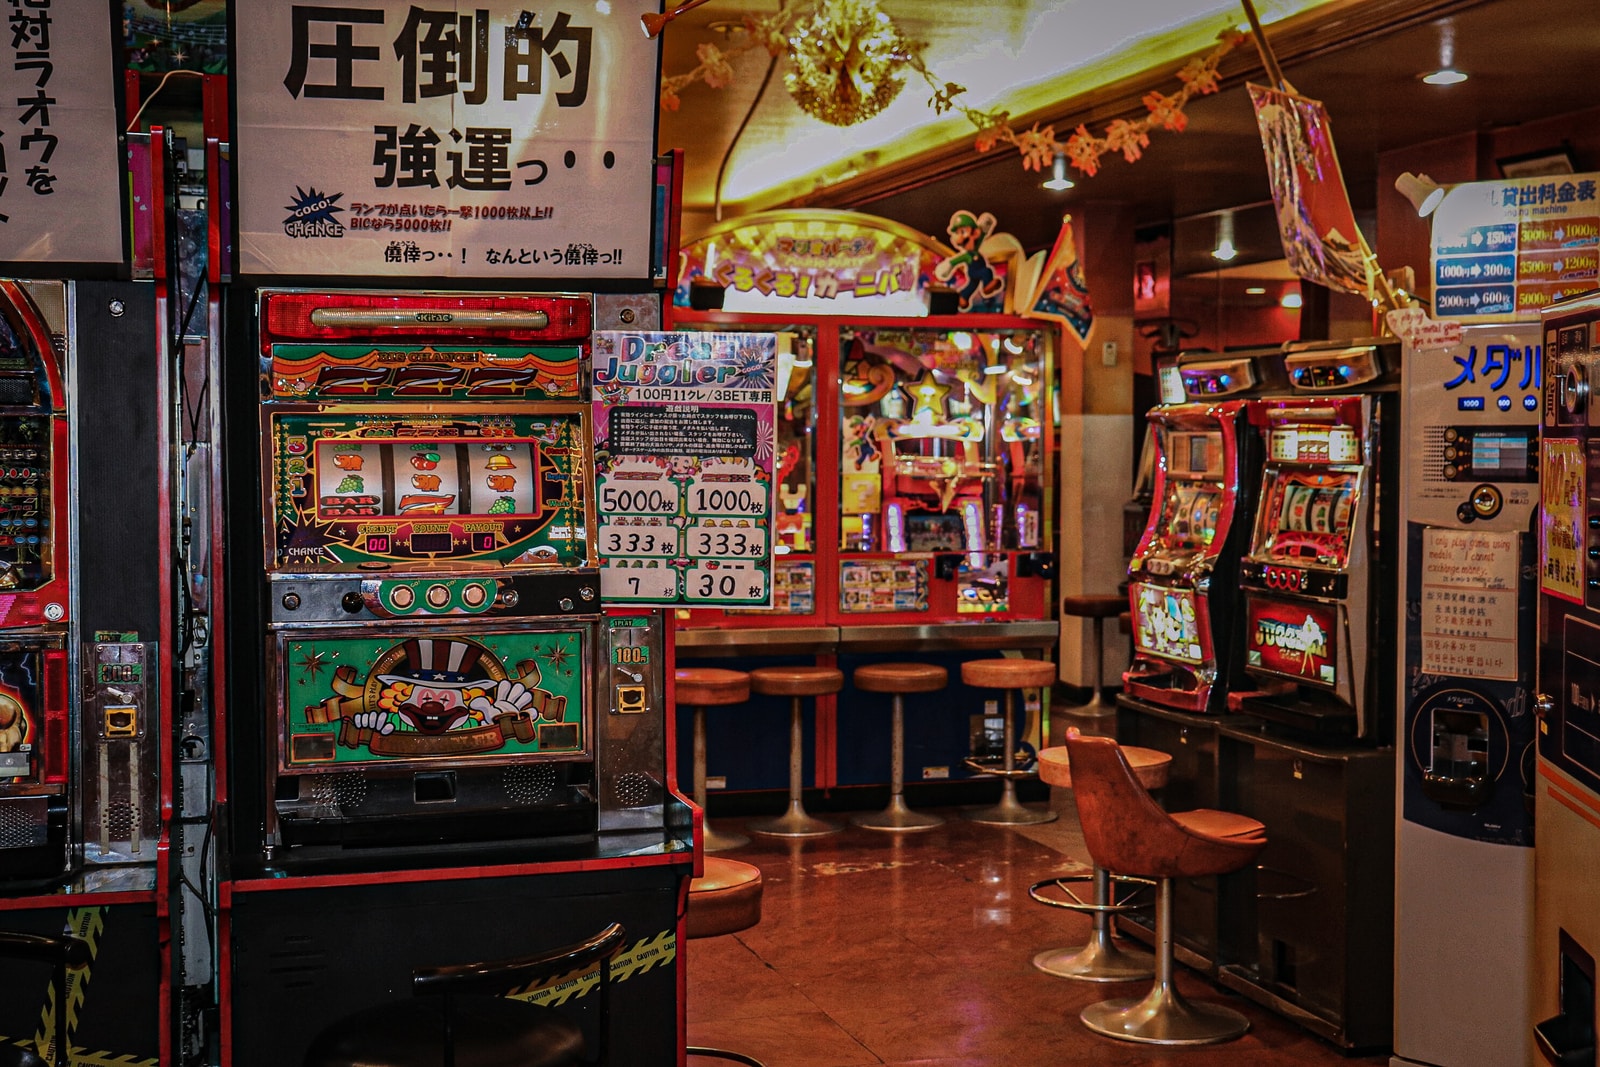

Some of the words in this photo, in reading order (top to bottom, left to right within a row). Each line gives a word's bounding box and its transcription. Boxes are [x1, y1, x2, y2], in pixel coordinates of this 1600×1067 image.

[283, 5, 593, 107] 圧倒的
[9, 0, 58, 195] 対ラオウを
[1487, 180, 1597, 207] 貸出料金表
[295, 198, 331, 217] GOGO!
[1532, 205, 1567, 215] machine
[285, 222, 344, 238] CHANCE
[597, 357, 737, 386] Juggler
[287, 436, 308, 455] 3
[287, 457, 307, 476] 2
[323, 496, 375, 505] BAR
[603, 488, 674, 512] 5000枚
[696, 488, 763, 513] 1000枚
[357, 525, 397, 534] CREDIT
[413, 524, 449, 532] COUNT
[464, 523, 503, 531] PAYOUT
[288, 547, 324, 556] CHANCE
[369, 538, 387, 551] 00
[608, 533, 674, 554] 333枚
[698, 533, 762, 556] 333枚
[79, 911, 92, 938] CAUTION
[527, 989, 551, 1003] CAUTION
[554, 978, 578, 992] CAUTION
[582, 970, 601, 982] CAUTIO
[609, 958, 633, 971] CAUTION
[636, 947, 659, 961] CAUTION
